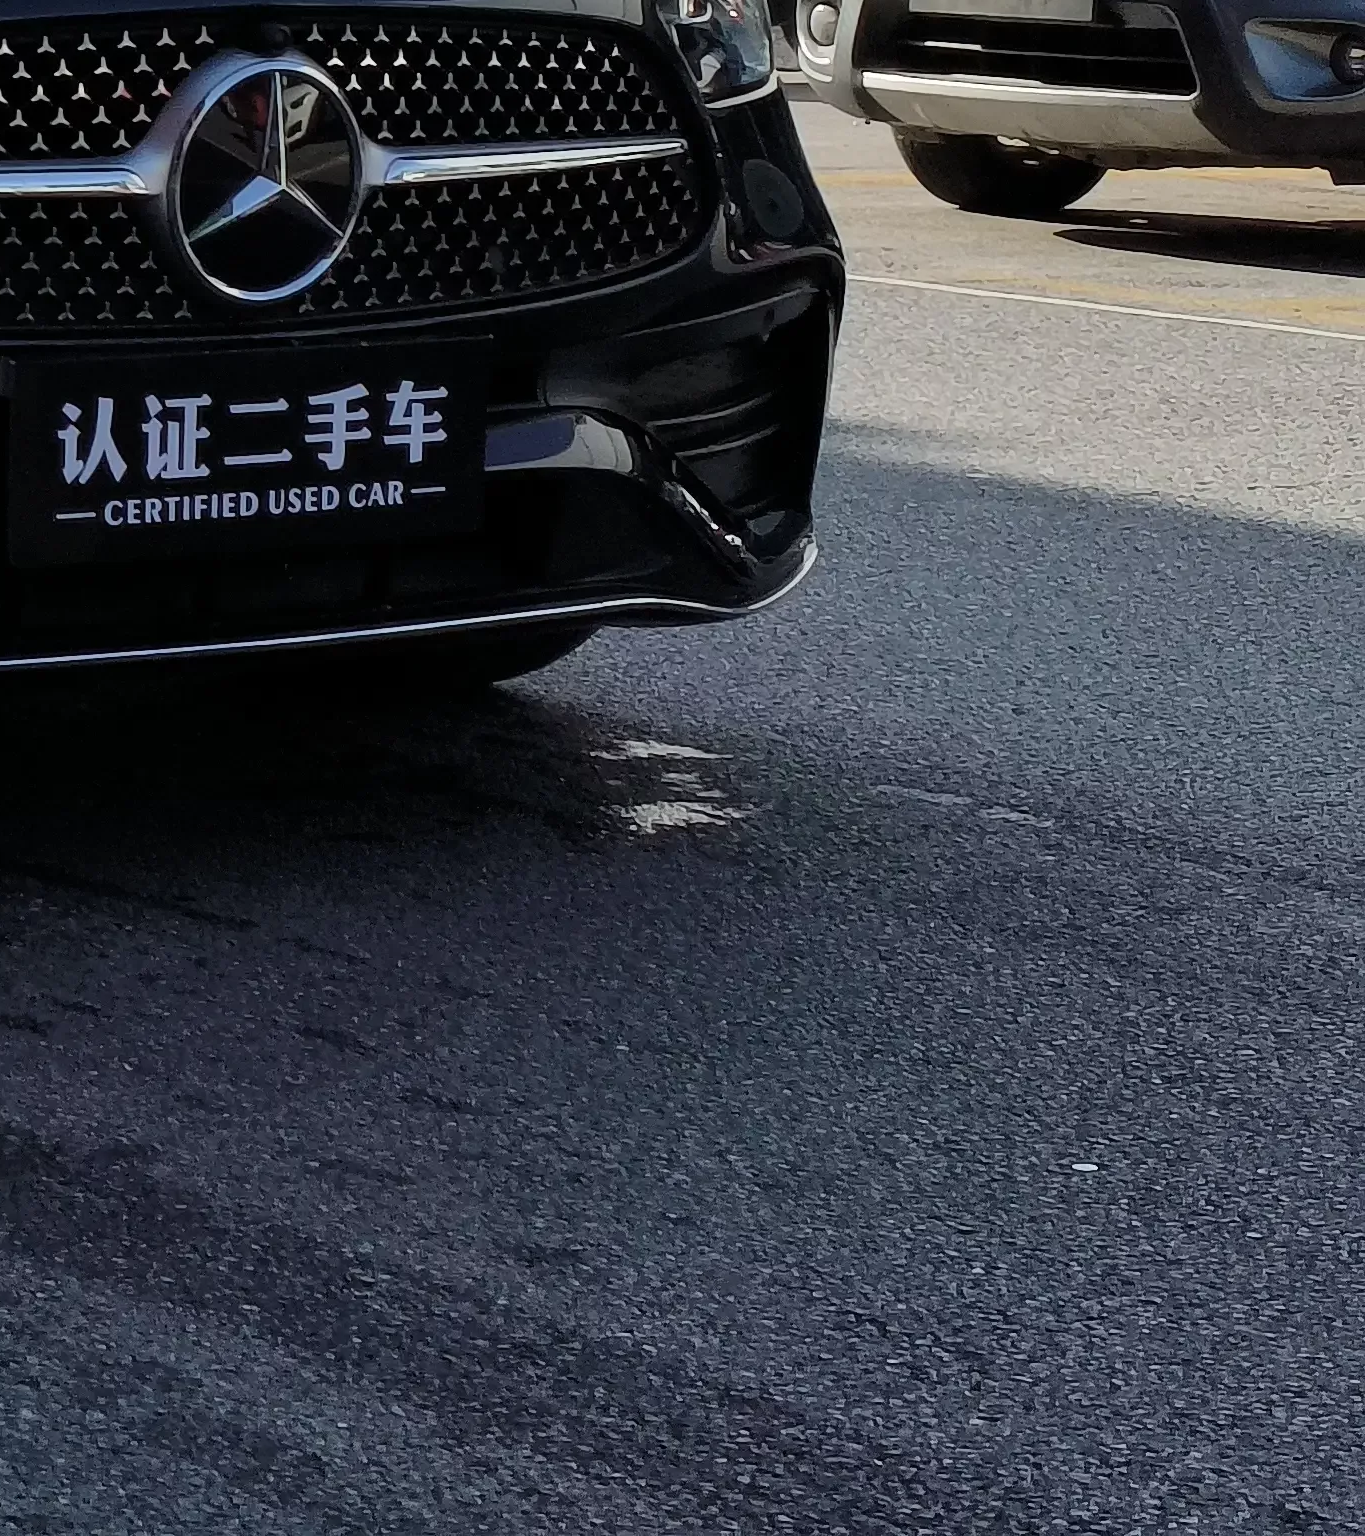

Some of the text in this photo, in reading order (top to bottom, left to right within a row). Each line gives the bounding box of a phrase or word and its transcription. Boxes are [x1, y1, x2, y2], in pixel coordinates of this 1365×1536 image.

[57, 379, 450, 485] 认证二手车
[103, 480, 404, 527] CERTIFIED USED CAR
